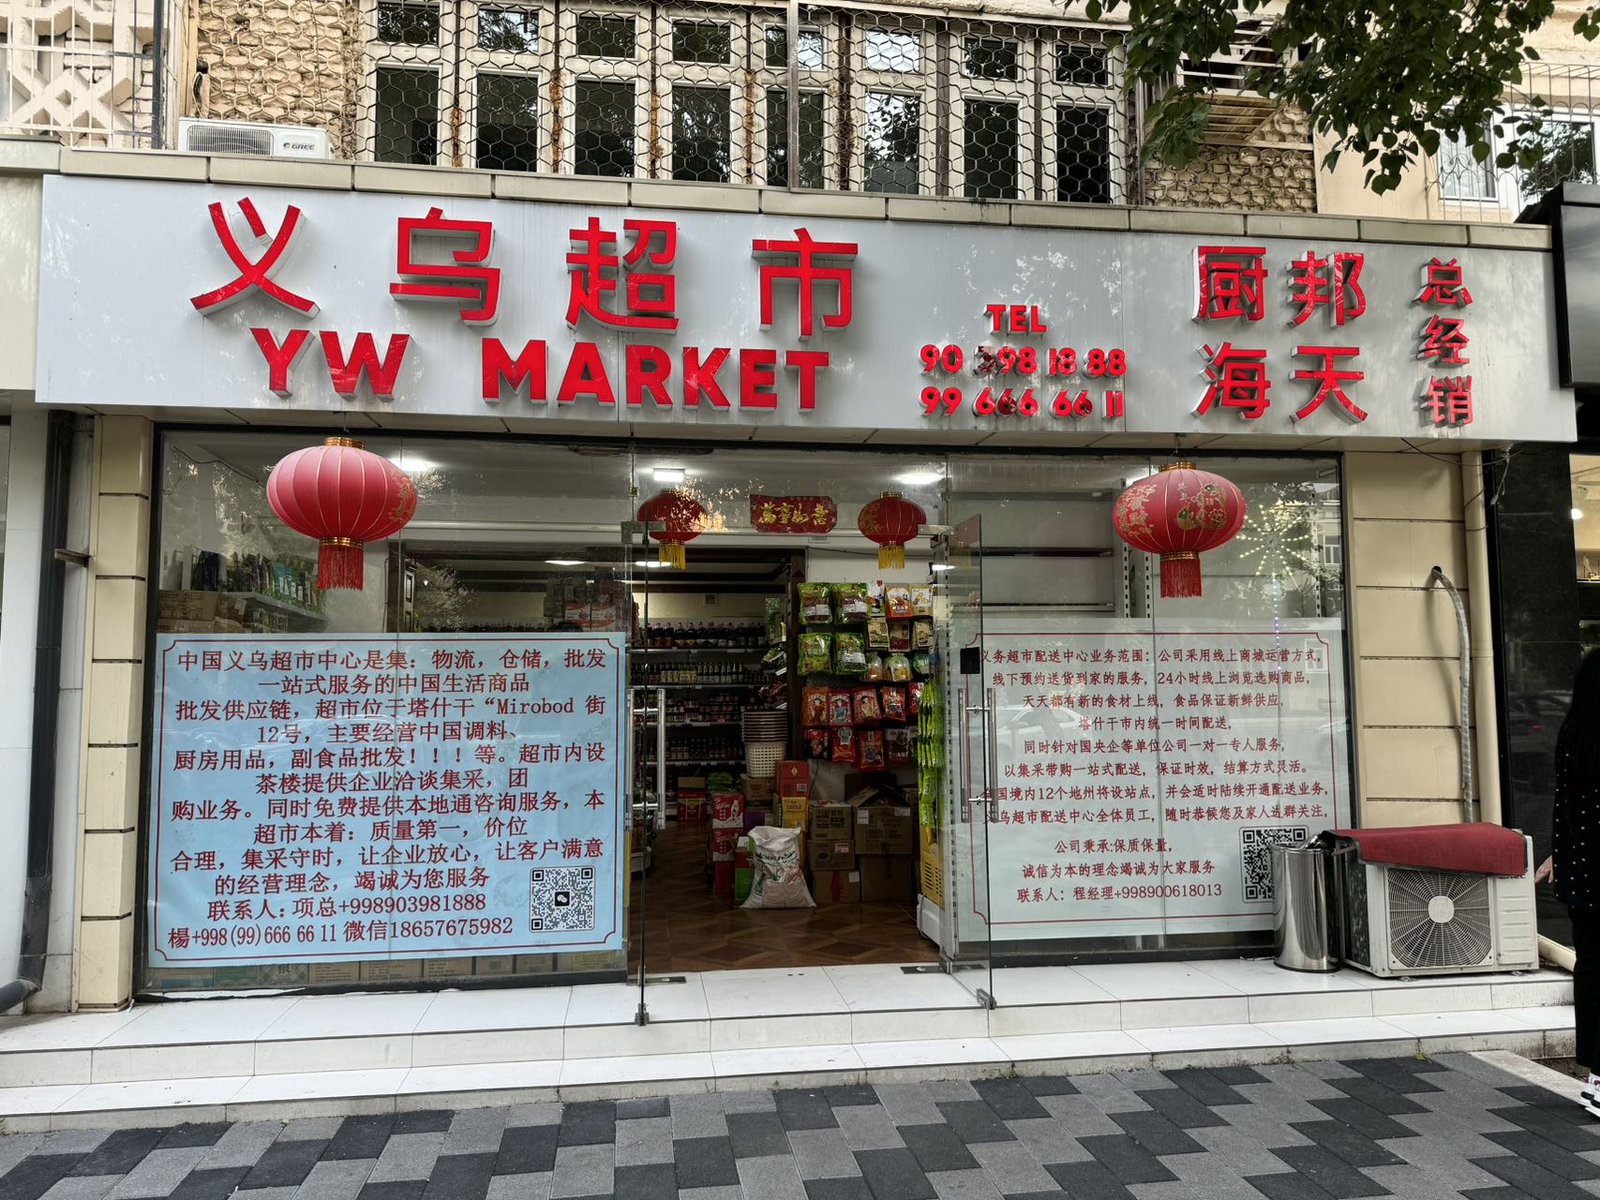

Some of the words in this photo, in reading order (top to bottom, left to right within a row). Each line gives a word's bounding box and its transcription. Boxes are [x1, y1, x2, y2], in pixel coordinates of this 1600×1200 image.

[190, 197, 858, 336] 义乌超市
[1196, 245, 1367, 327] 厨邦
[986, 304, 1047, 334] TEL
[1418, 257, 1474, 426] 总经销
[250, 328, 411, 398] YW
[481, 337, 829, 413] MARKET
[920, 344, 964, 375] 90
[1048, 347, 1077, 377] 18
[1086, 348, 1127, 377] 88
[1195, 342, 1368, 424] 海天
[920, 386, 963, 415] 99
[976, 387, 1039, 417] 666
[1053, 389, 1094, 417] 66
[258, 673, 529, 695] 一站式服务的中国生活商品
[585, 695, 606, 715] 街
